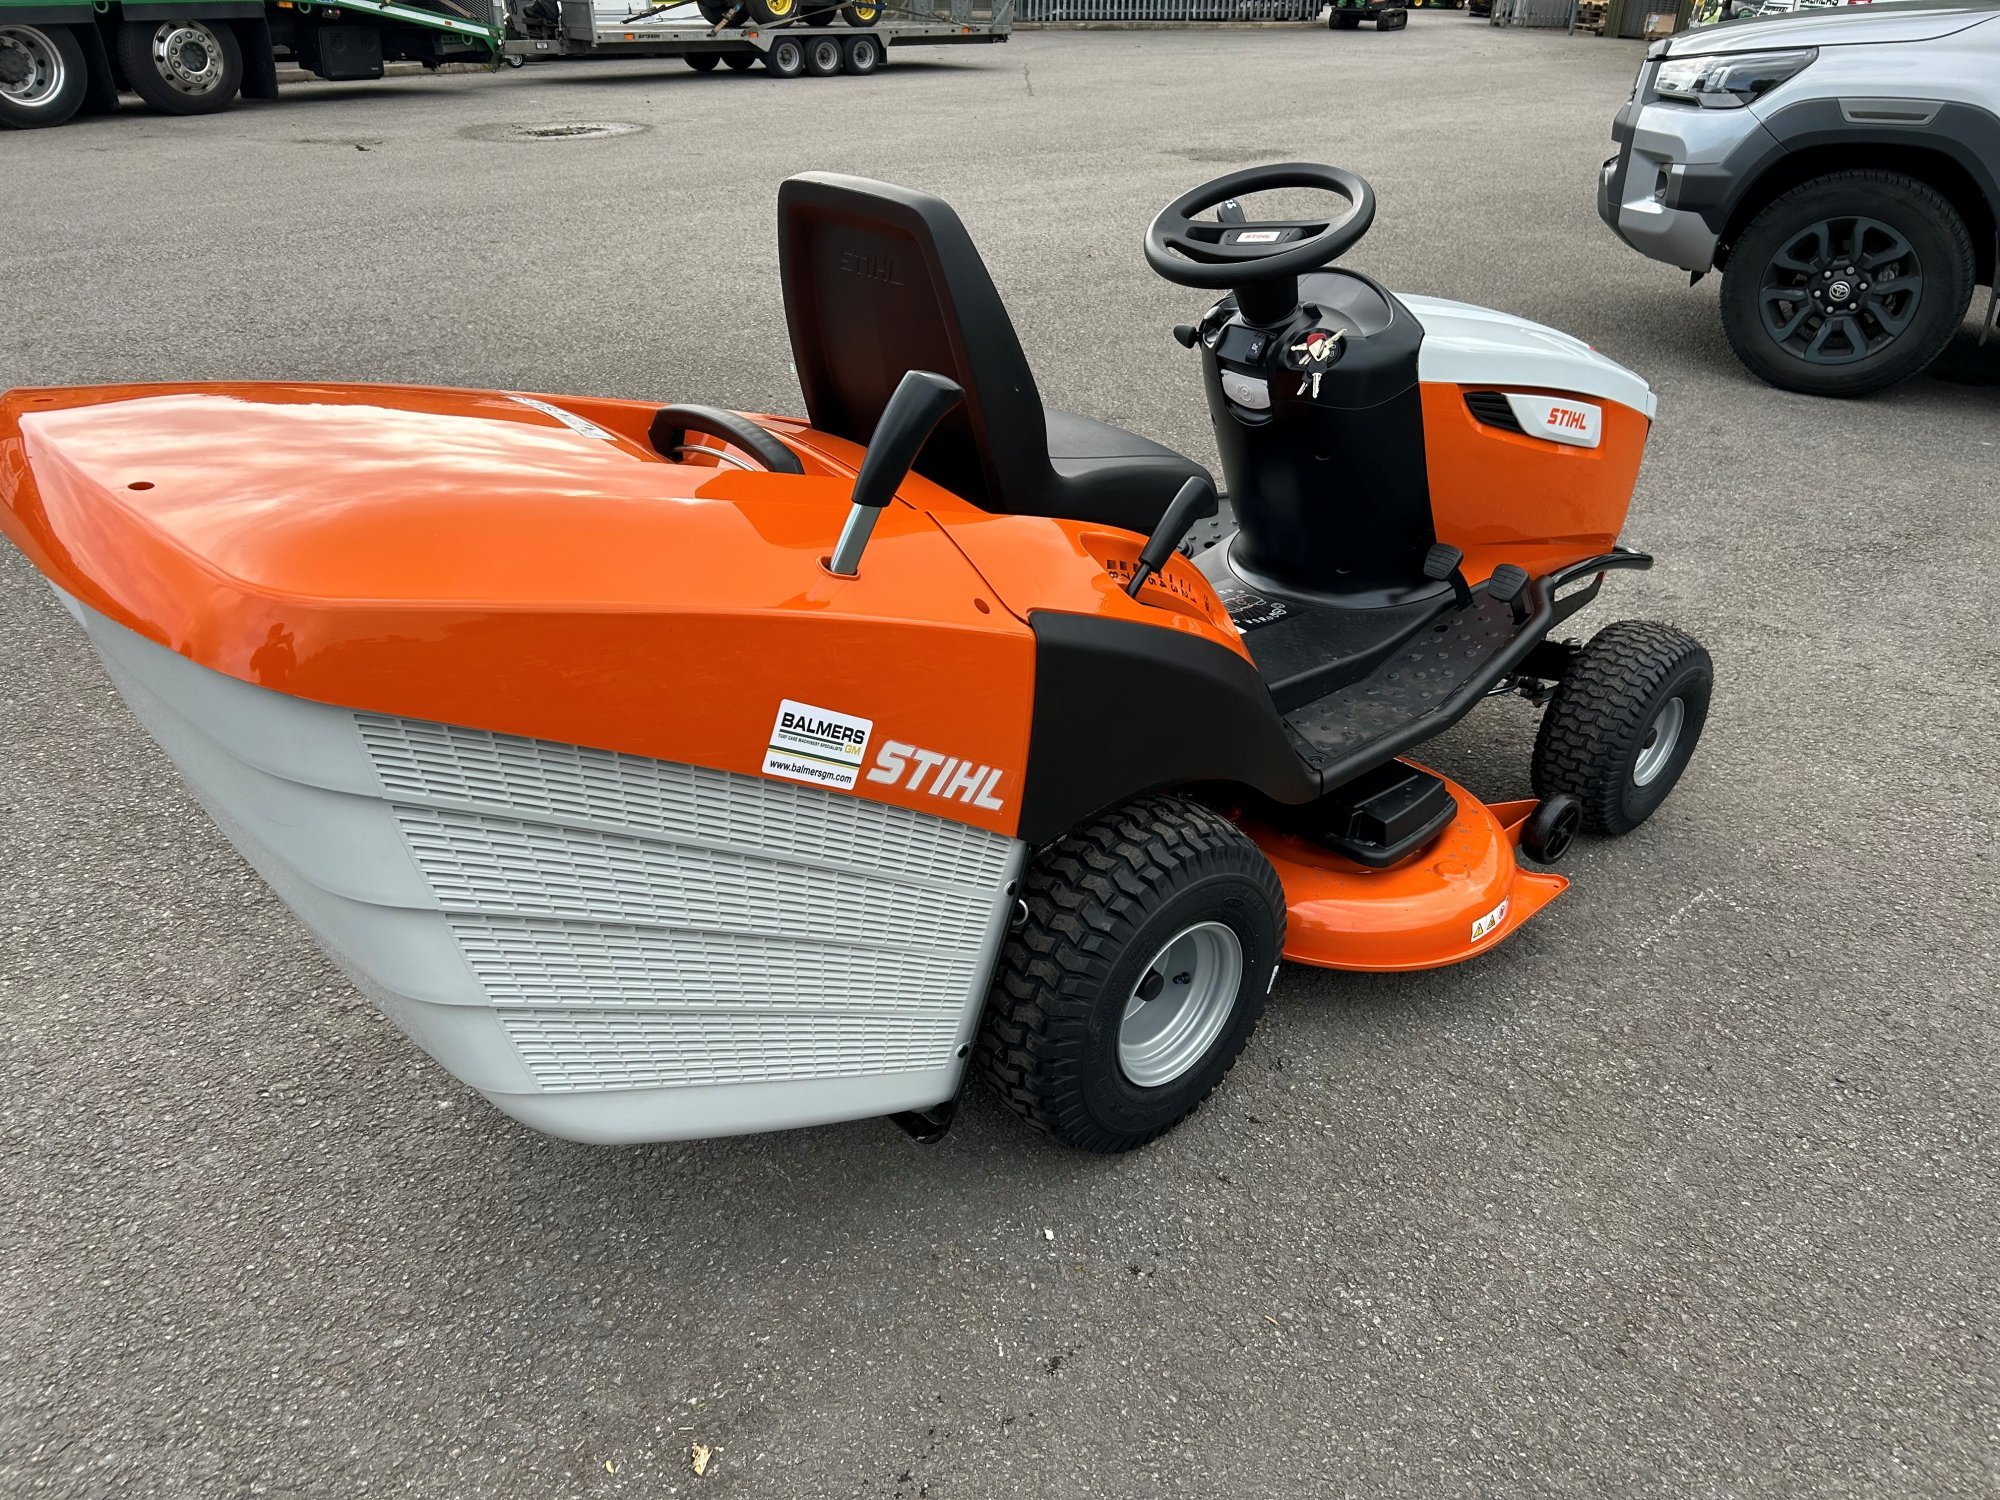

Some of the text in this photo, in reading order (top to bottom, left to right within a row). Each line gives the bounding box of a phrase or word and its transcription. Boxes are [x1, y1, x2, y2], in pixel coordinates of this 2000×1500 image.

[839, 247, 905, 286] STIHL
[1547, 407, 1587, 430] STIHL
[1108, 571, 1118, 579] 8
[1148, 576, 1157, 586] 5
[1159, 580, 1167, 589] 4
[1170, 584, 1178, 593] 3
[781, 712, 865, 745] BALMERS
[798, 738, 820, 747] MACHINERY
[820, 742, 843, 751] SPECIALISTS
[844, 744, 861, 756] GM
[769, 760, 852, 784] www.balmersgm.com
[866, 739, 1004, 811] STIHL
